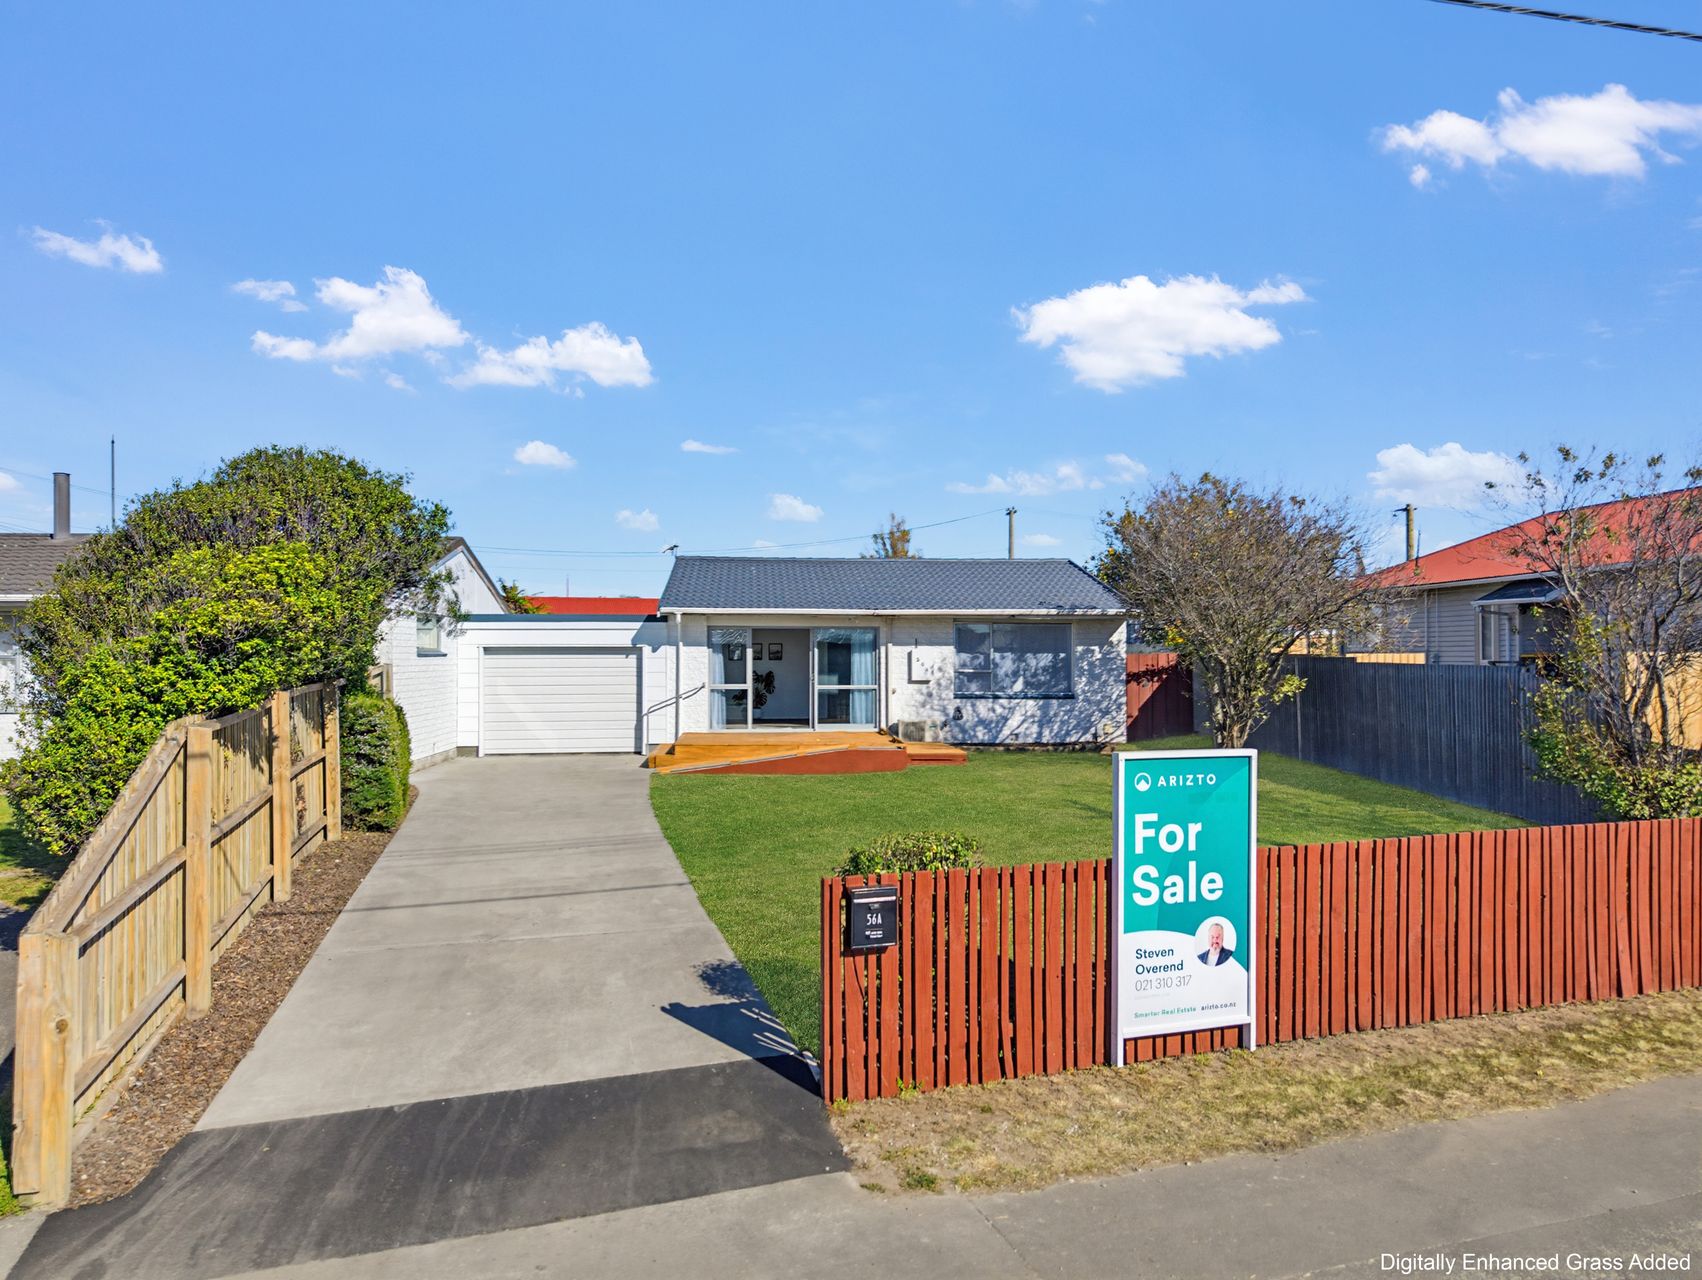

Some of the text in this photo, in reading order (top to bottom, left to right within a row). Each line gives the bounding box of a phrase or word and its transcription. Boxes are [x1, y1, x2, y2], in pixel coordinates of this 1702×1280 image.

[1157, 773, 1217, 788] ARIZTO
[1134, 812, 1202, 855] For
[1132, 860, 1224, 907] Sale
[866, 912, 882, 926] 56A
[1135, 948, 1174, 960] Steven
[1135, 960, 1184, 975] Overend
[1135, 974, 1192, 992] 021 310 317
[1201, 1002, 1237, 1011] arizto.co.nz
